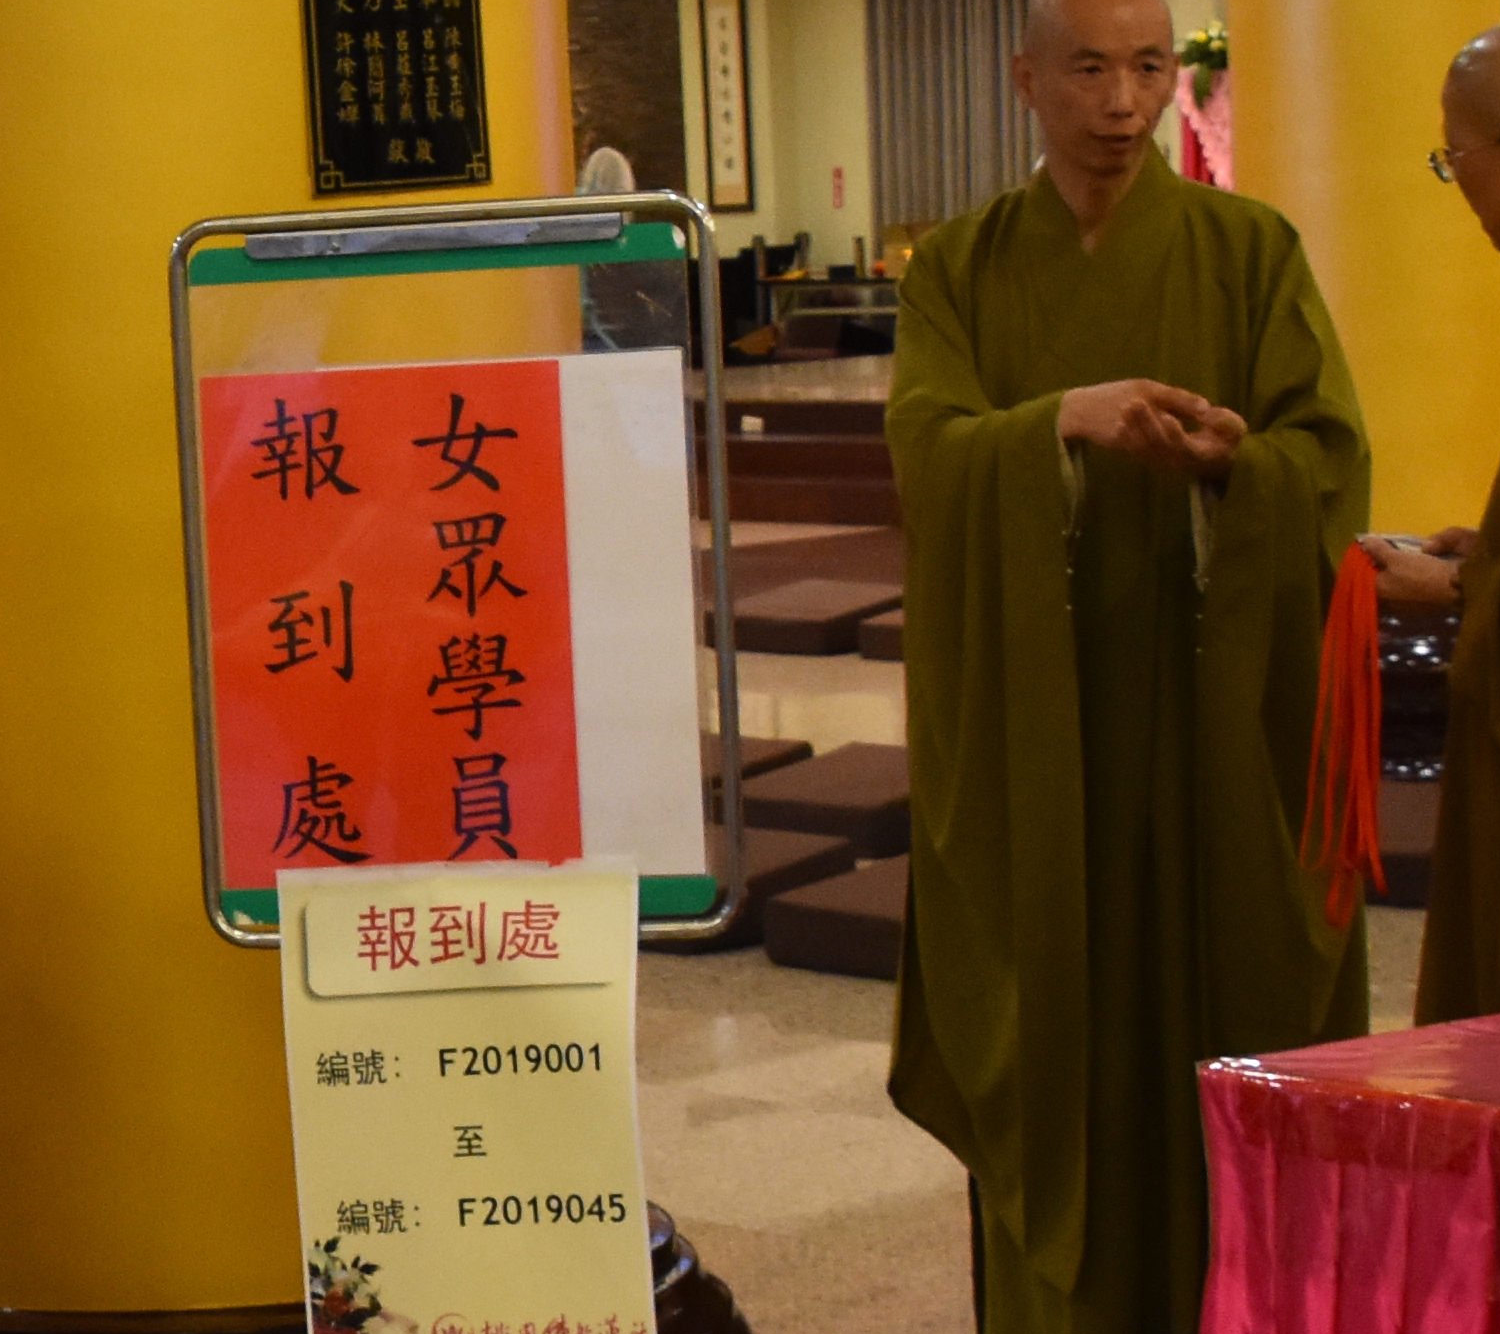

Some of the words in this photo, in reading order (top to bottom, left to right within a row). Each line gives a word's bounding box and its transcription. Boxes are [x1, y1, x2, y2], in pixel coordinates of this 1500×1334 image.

[250, 397, 375, 865] 報到處
[412, 393, 529, 861] 女眾學員
[356, 899, 561, 972] 報到處
[438, 1043, 602, 1077] F2019001
[453, 1124, 488, 1159] 至
[458, 1193, 627, 1228] F2019045
